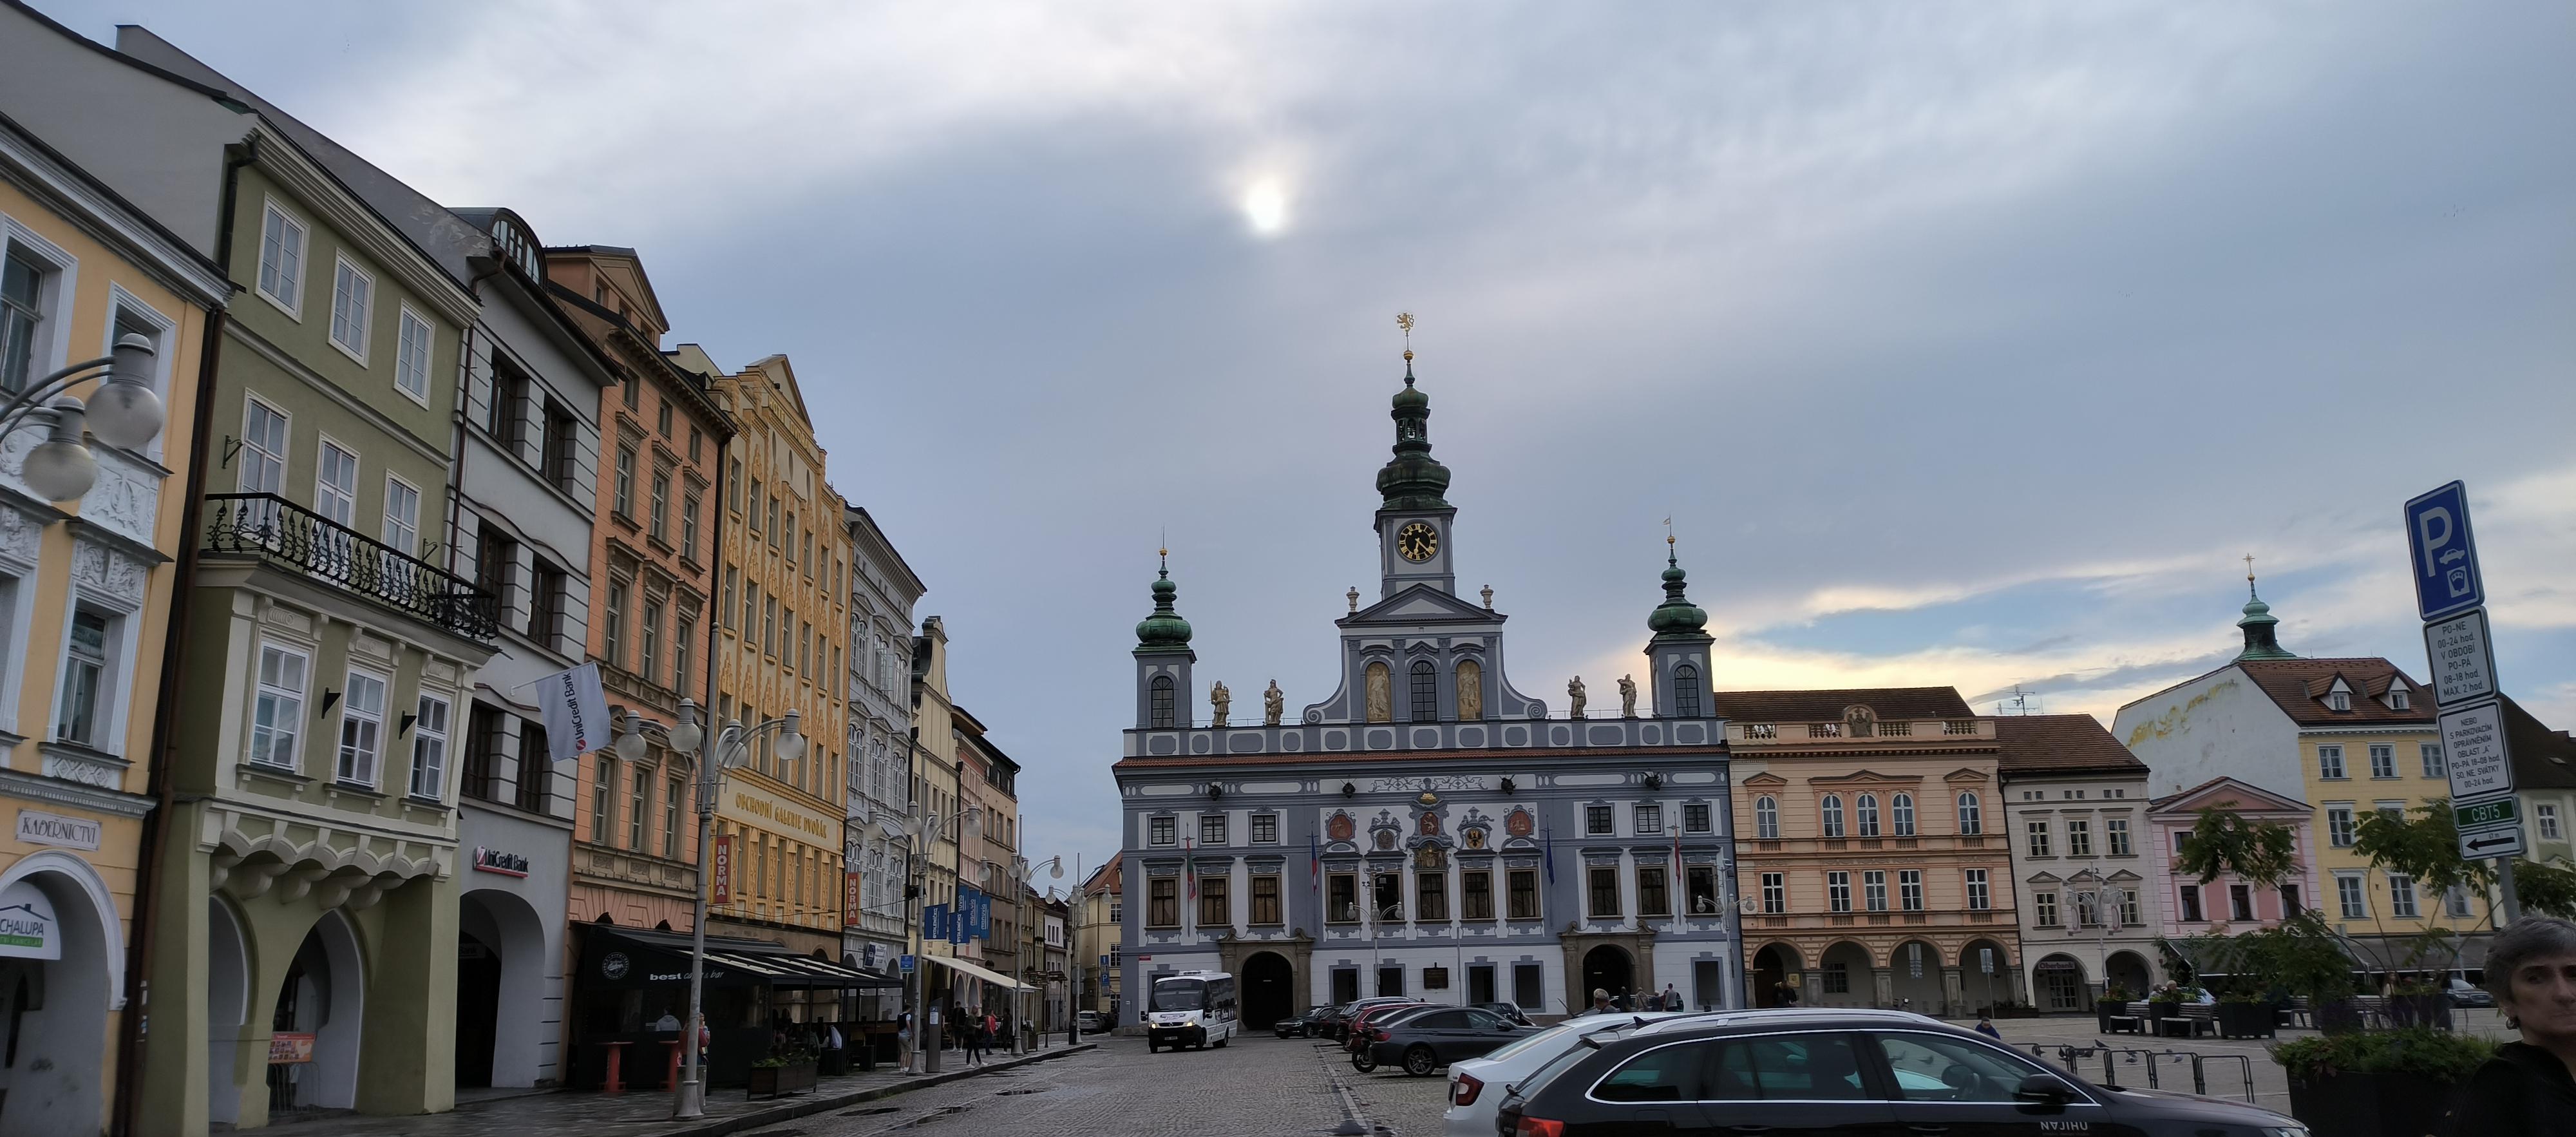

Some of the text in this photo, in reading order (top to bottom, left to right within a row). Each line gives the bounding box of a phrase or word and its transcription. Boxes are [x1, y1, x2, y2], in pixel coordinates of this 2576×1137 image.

[2419, 506, 2452, 578] P
[2442, 621, 2467, 635] PO-NE
[2438, 636, 2458, 649] 00-24
[2441, 642, 2476, 660] V OBDOBÍ
[2448, 656, 2472, 671] PO-PÁ
[2444, 672, 2463, 684] 08-18
[2463, 684, 2468, 693] 2
[562, 671, 584, 740] UniCredit Bank
[2460, 717, 2477, 726] NEBO
[2455, 723, 2493, 738] PARKOVACÍM
[2454, 734, 2492, 749] OPRÁVNĚNÍM
[2458, 747, 2480, 758] OBLAST
[2451, 758, 2470, 770] PO-PÁ
[2471, 757, 2487, 765] 18-08
[2477, 765, 2499, 776] SVÁTKY
[2464, 779, 2481, 788] 00-24
[735, 792, 828, 839] OBCHODNÍ GALERIE DVOŘÁK
[2472, 804, 2500, 822] CBT5
[22, 816, 97, 844] KADEŘNICTVÍ
[485, 848, 529, 872] UniCredit Bank
[716, 845, 727, 896] NORMA
[848, 878, 857, 919] NORMA
[0, 919, 44, 936] CHALUPA
[710, 970, 724, 979] bar
